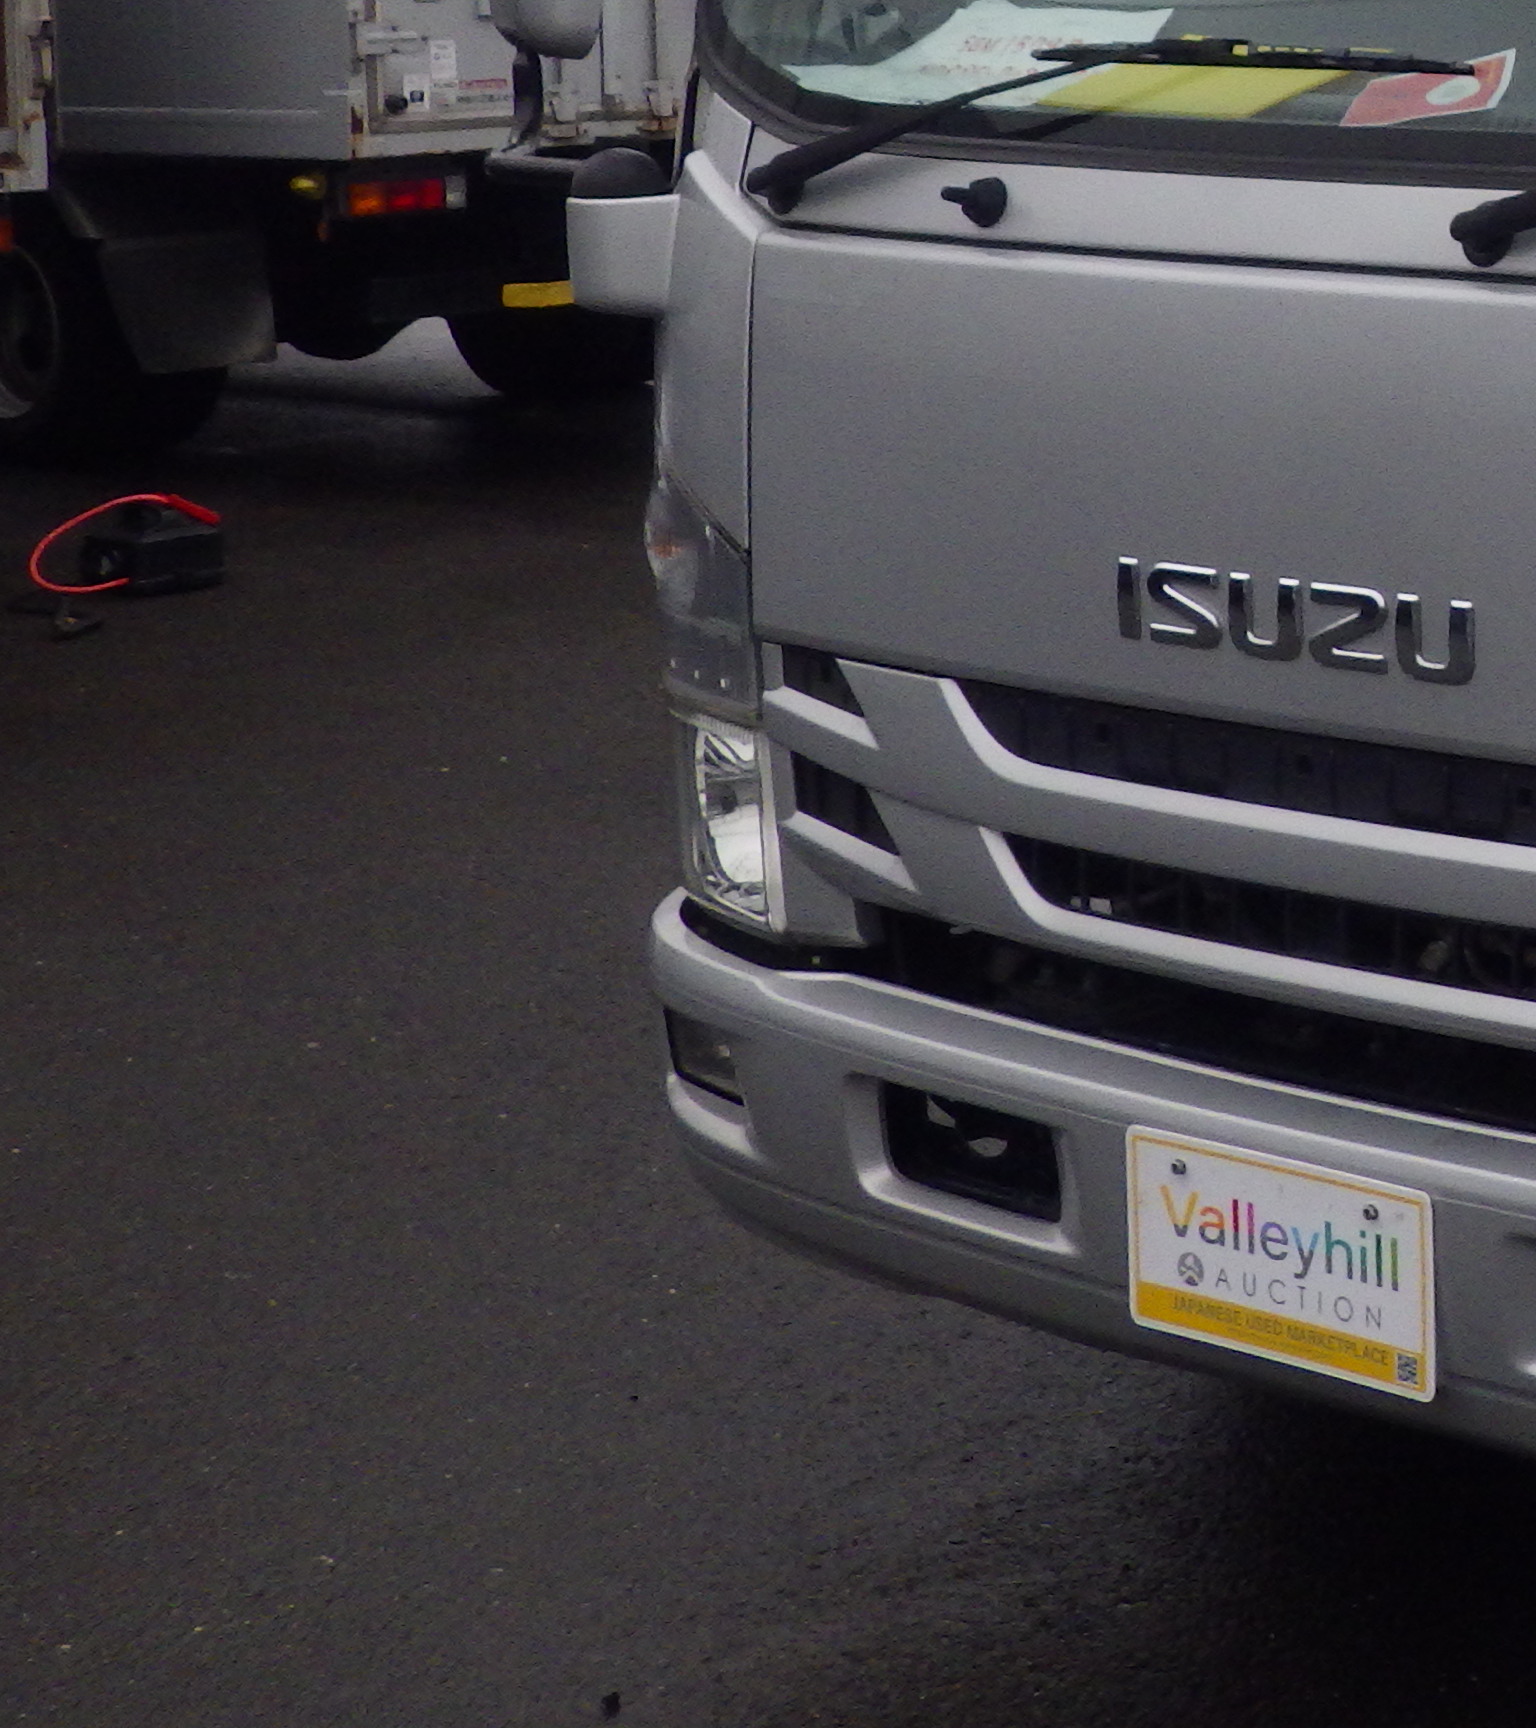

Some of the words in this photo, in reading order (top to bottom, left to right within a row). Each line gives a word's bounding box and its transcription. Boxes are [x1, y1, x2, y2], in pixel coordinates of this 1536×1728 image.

[1117, 555, 1477, 686] ISUZU
[1160, 1184, 1400, 1292] Valleyhill
[1173, 1296, 1243, 1327] JAPANESE
[1246, 1316, 1283, 1336] USED
[1286, 1324, 1389, 1367] MARKETPLACE
[1216, 1268, 1383, 1331] AUCTION
